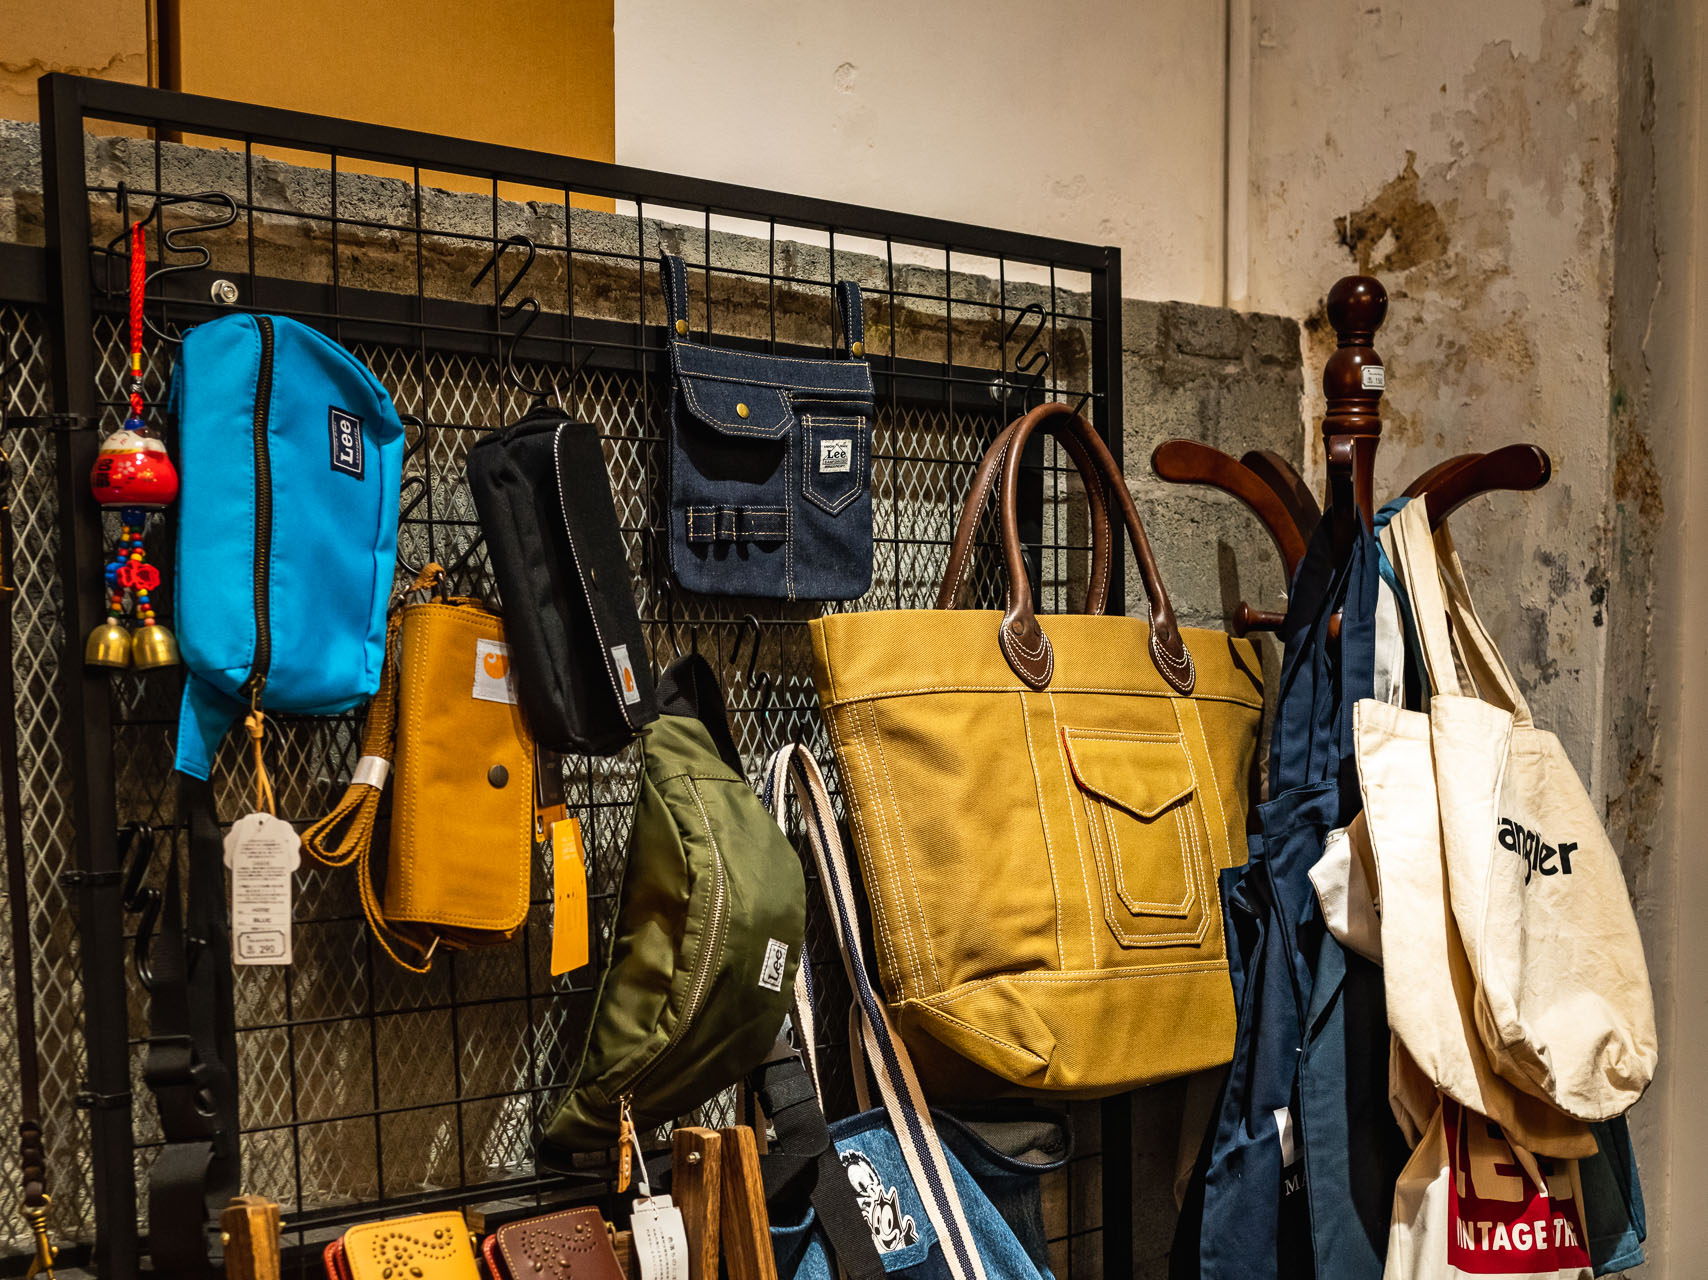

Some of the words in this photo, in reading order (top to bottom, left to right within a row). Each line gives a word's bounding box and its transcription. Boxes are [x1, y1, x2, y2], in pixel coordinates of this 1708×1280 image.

[340, 420, 354, 465] Lee
[827, 449, 846, 459] Lee
[1497, 816, 1578, 886] angler
[767, 949, 783, 981] Lee
[1456, 1215, 1548, 1251] INTAGE
